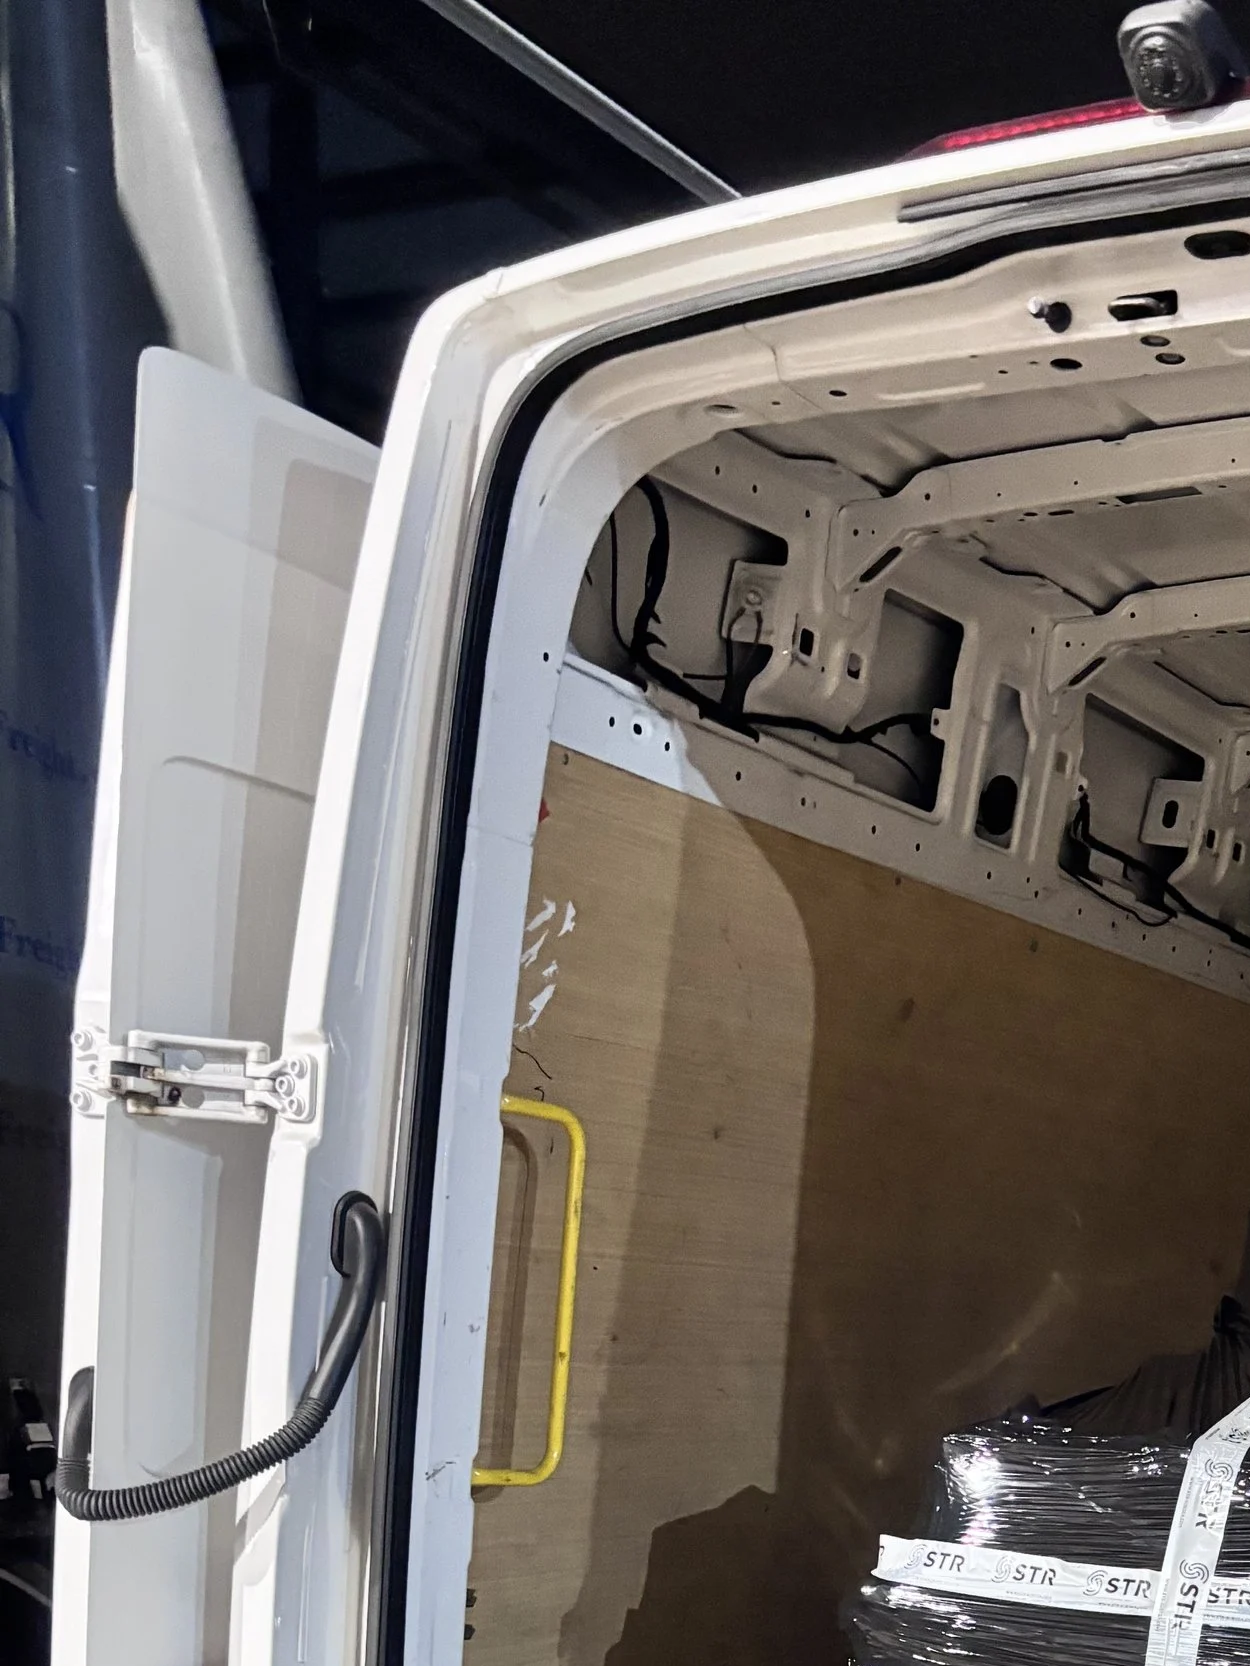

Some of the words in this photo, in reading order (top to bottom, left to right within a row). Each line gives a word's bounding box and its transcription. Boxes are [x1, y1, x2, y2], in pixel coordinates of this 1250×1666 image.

[923, 1550, 965, 1573] STR
[1013, 1563, 1057, 1586] STR
[1105, 1577, 1151, 1599] STR
